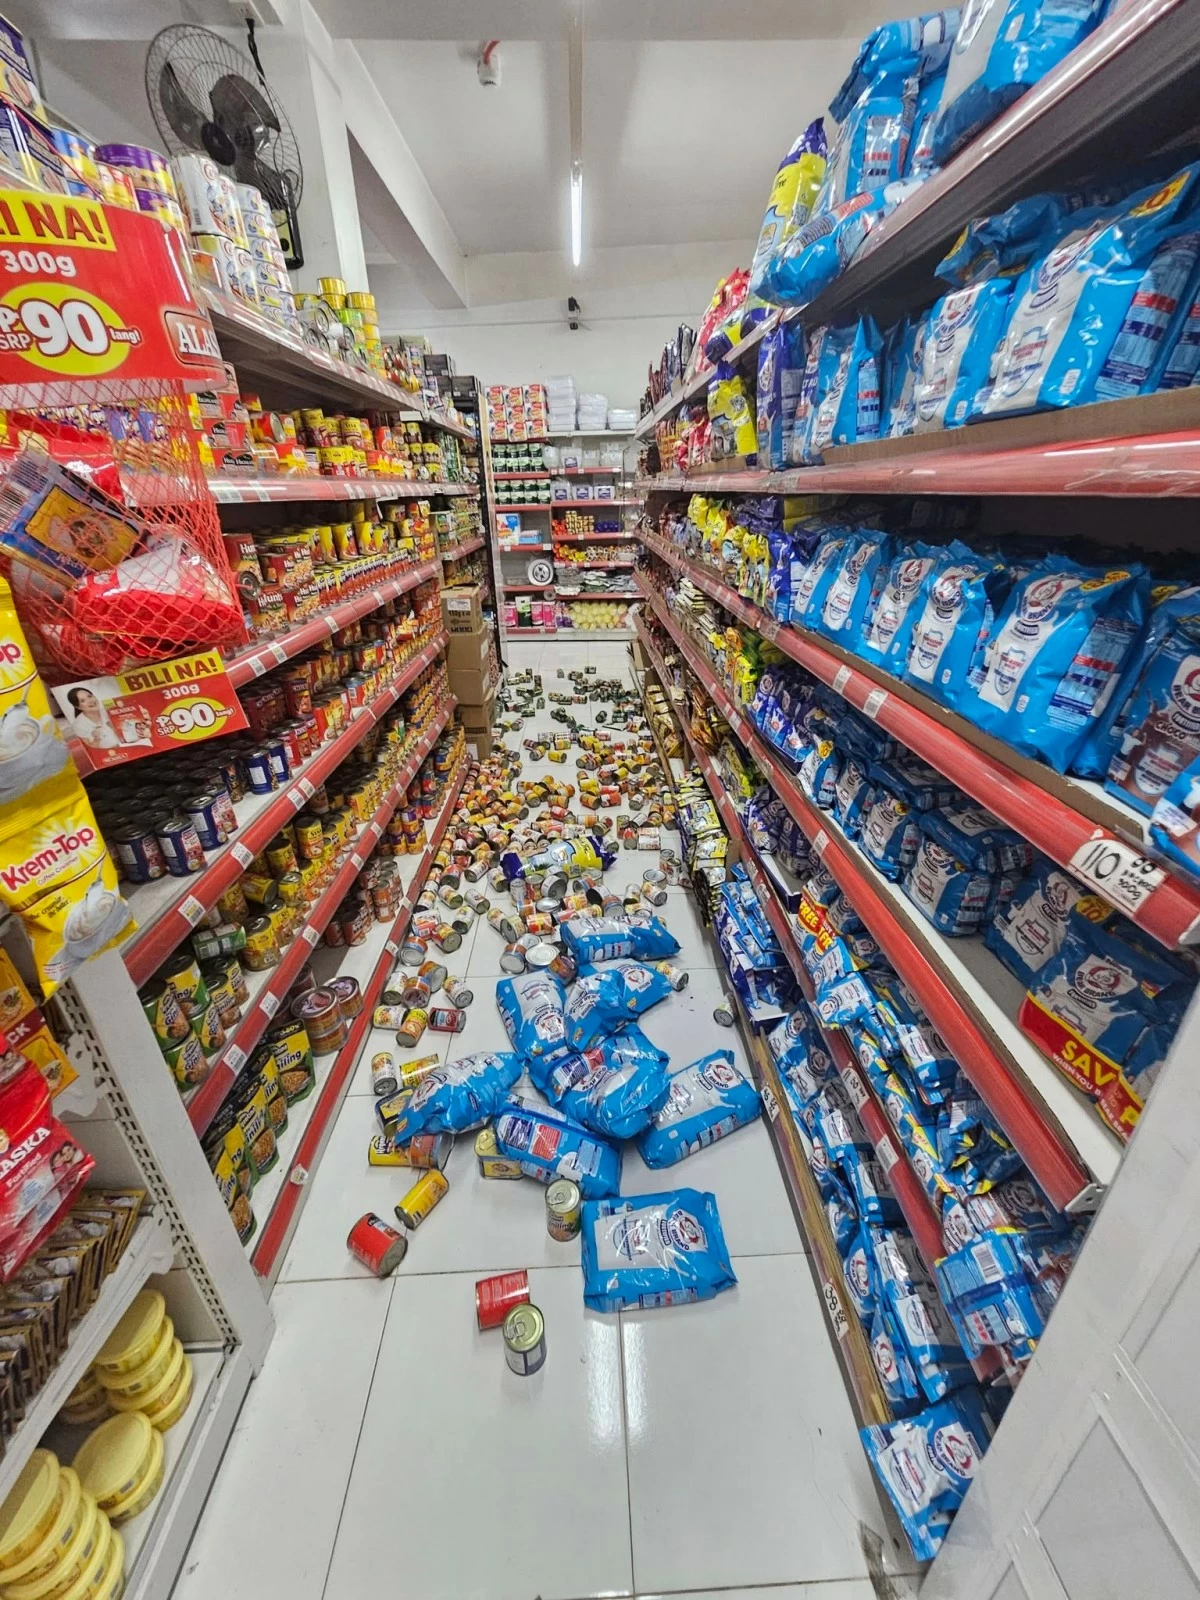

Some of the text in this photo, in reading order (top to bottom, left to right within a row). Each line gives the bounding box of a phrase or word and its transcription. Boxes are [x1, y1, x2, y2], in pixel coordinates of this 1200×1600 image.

[22, 200, 108, 245] NA!
[0, 250, 77, 277] 300g
[110, 327, 141, 344] lang!
[124, 657, 218, 692] BILI NA!
[162, 683, 200, 700] 300g
[1173, 684, 1192, 711] BEAR
[157, 725, 176, 736] SRP
[1155, 721, 1186, 739] CHOCO
[1, 828, 94, 890] Krem-Top
[1084, 987, 1116, 997] BRAND
[709, 1076, 729, 1088] BRAND
[1053, 1053, 1075, 1074] WHEN
[1076, 1074, 1093, 1090] YOU
[0, 1127, 51, 1179] ASKA
[6, 1152, 42, 1188] Fortified
[671, 1229, 690, 1251] BRAND
[936, 1430, 966, 1477] BEAR BRAND
